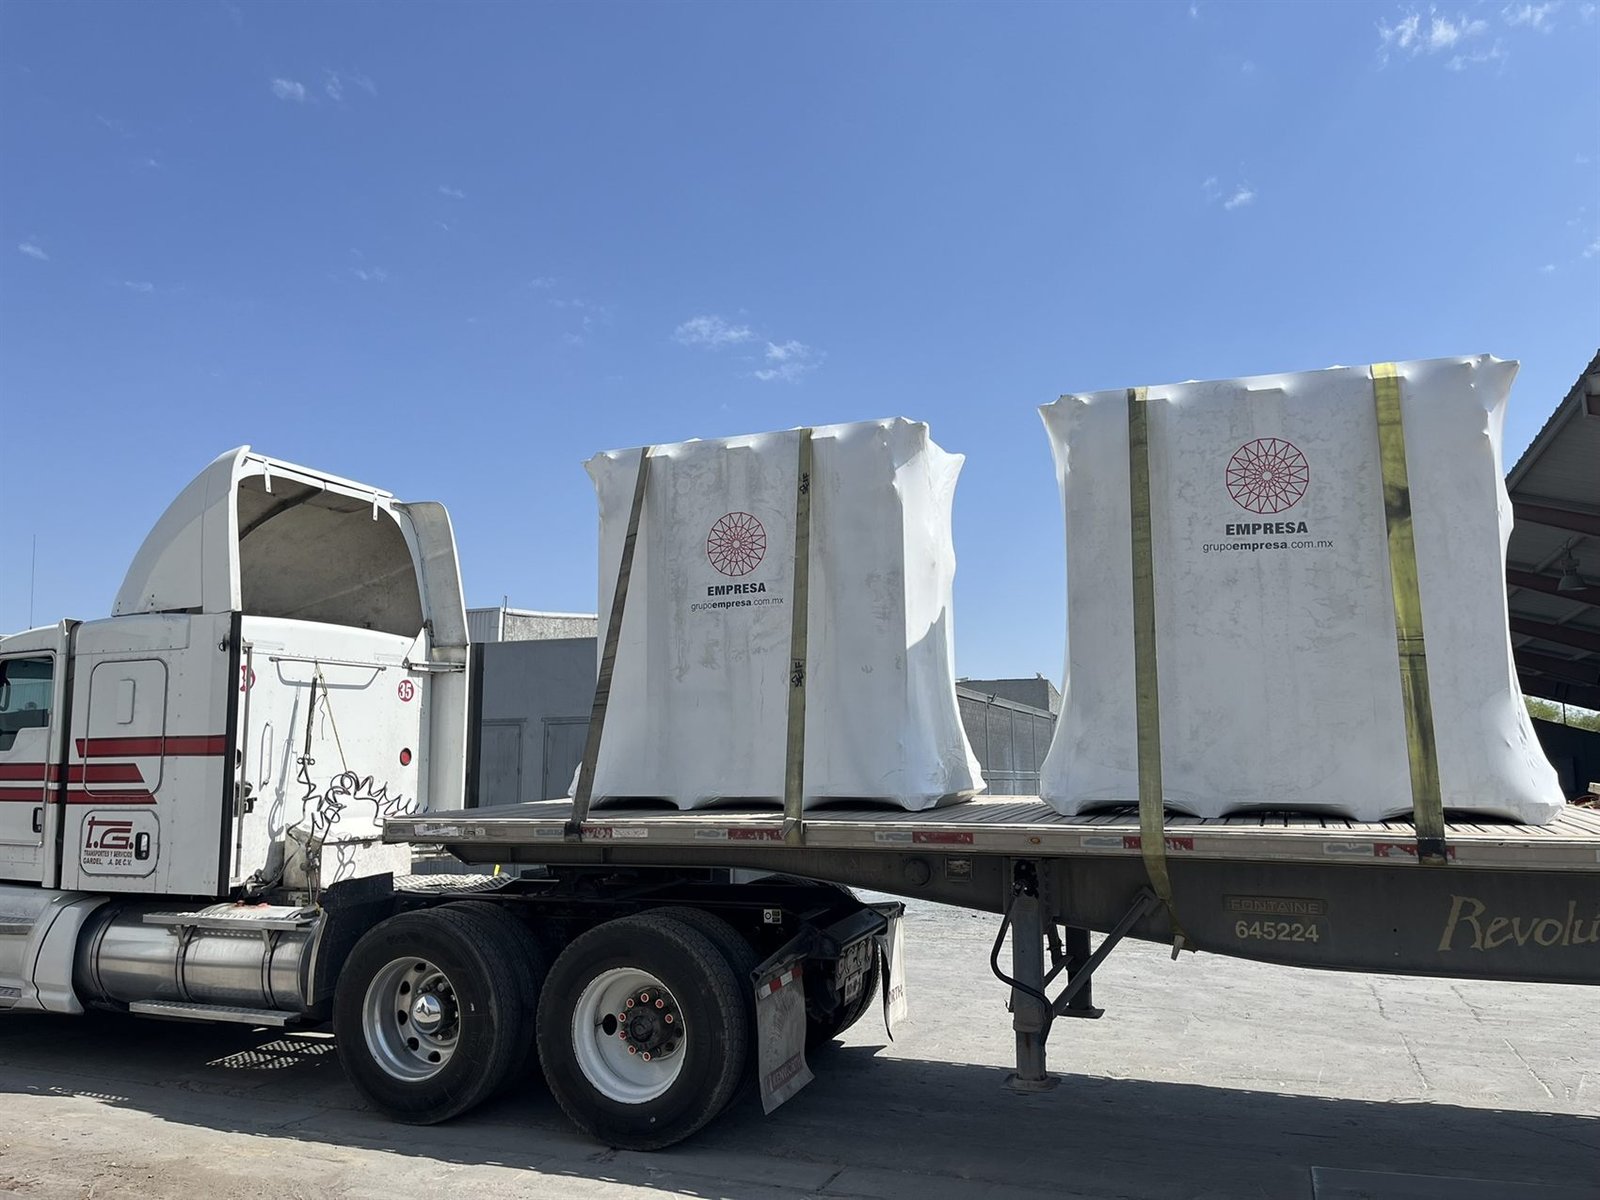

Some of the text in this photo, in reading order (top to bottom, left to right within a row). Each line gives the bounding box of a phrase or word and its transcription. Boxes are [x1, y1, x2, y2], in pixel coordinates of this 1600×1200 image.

[1225, 521, 1309, 536] EMPRESA
[1202, 540, 1334, 553] grupoempresa.com.mx
[707, 582, 767, 597] EMPRESA
[690, 597, 784, 612] grupoempresa.com.mx
[398, 681, 413, 700] 35
[84, 849, 110, 858] TRANSPORTES
[113, 850, 133, 859] SERVICIOS
[1231, 899, 1319, 914] FONTAINE
[1235, 920, 1320, 942] 645224
